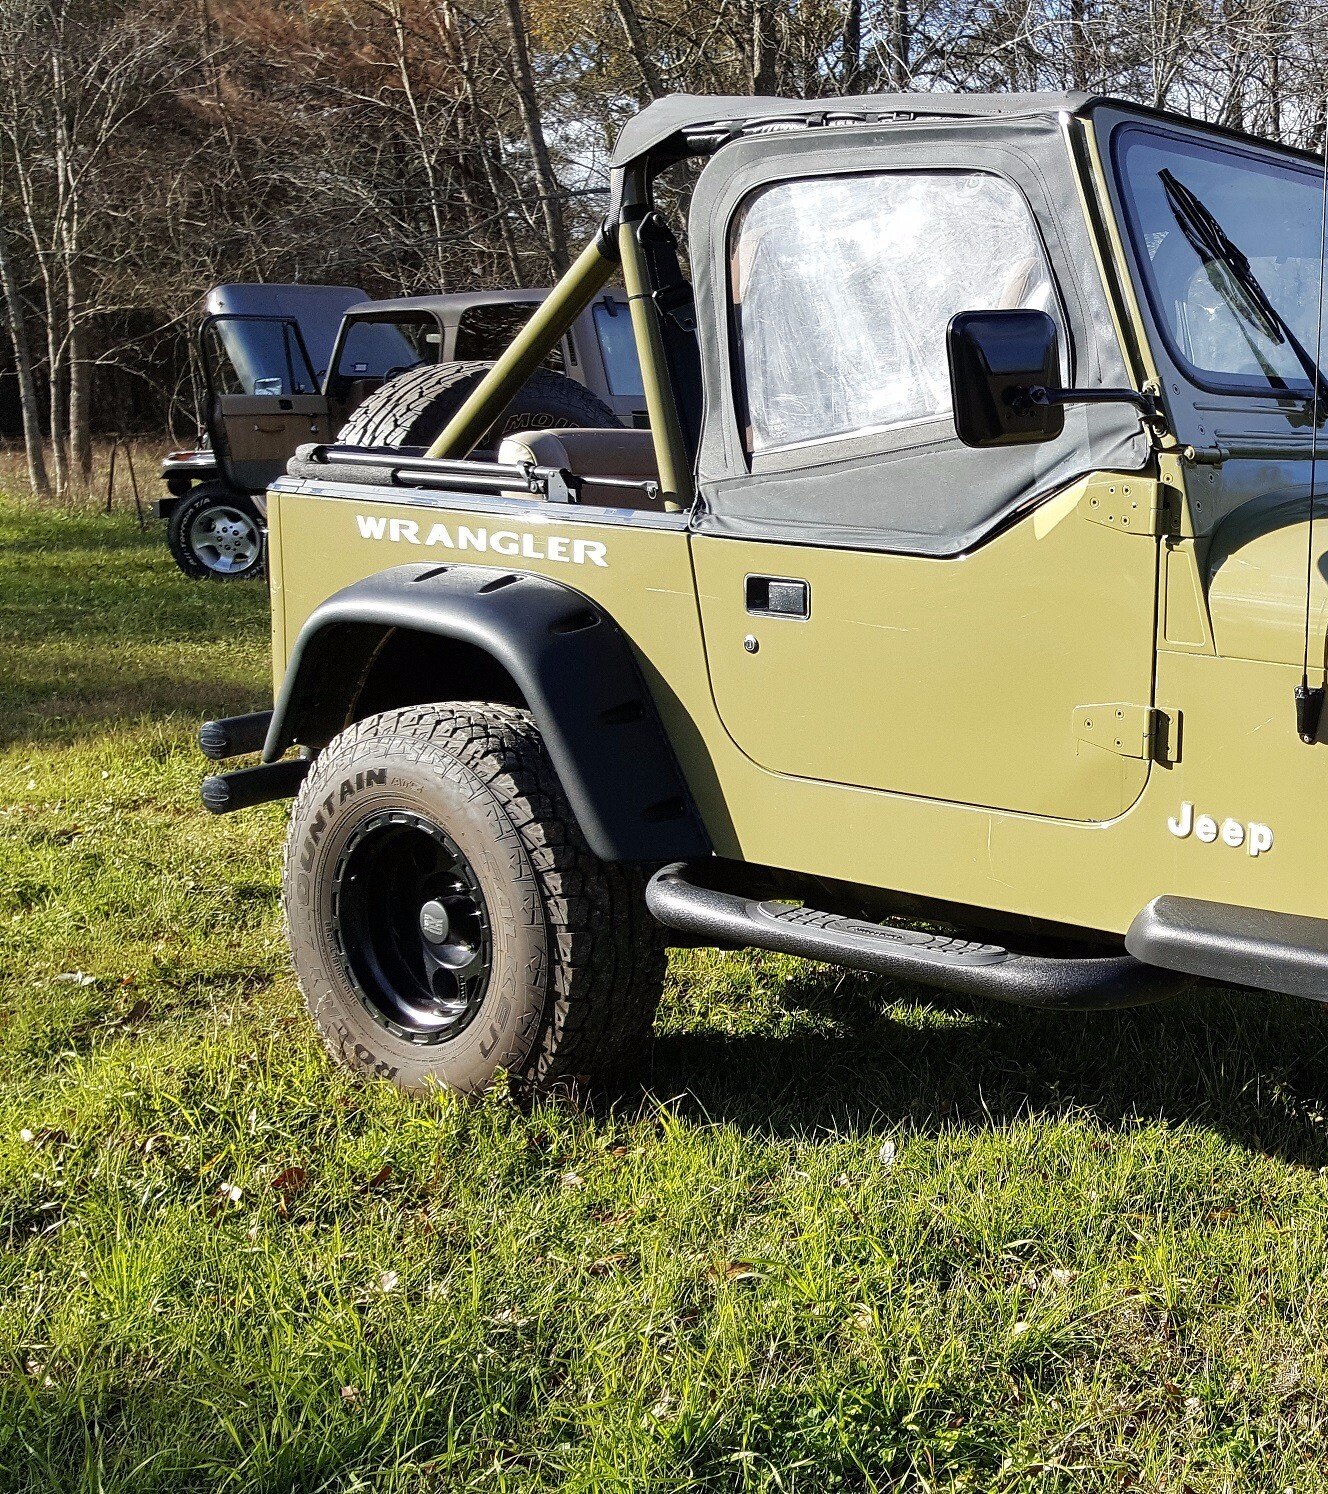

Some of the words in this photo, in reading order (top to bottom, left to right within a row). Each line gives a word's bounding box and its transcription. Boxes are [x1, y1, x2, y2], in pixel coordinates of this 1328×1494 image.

[355, 515, 609, 568] WRANGLER
[298, 766, 388, 950] MOUNTAIN
[1167, 800, 1274, 858] Jeep
